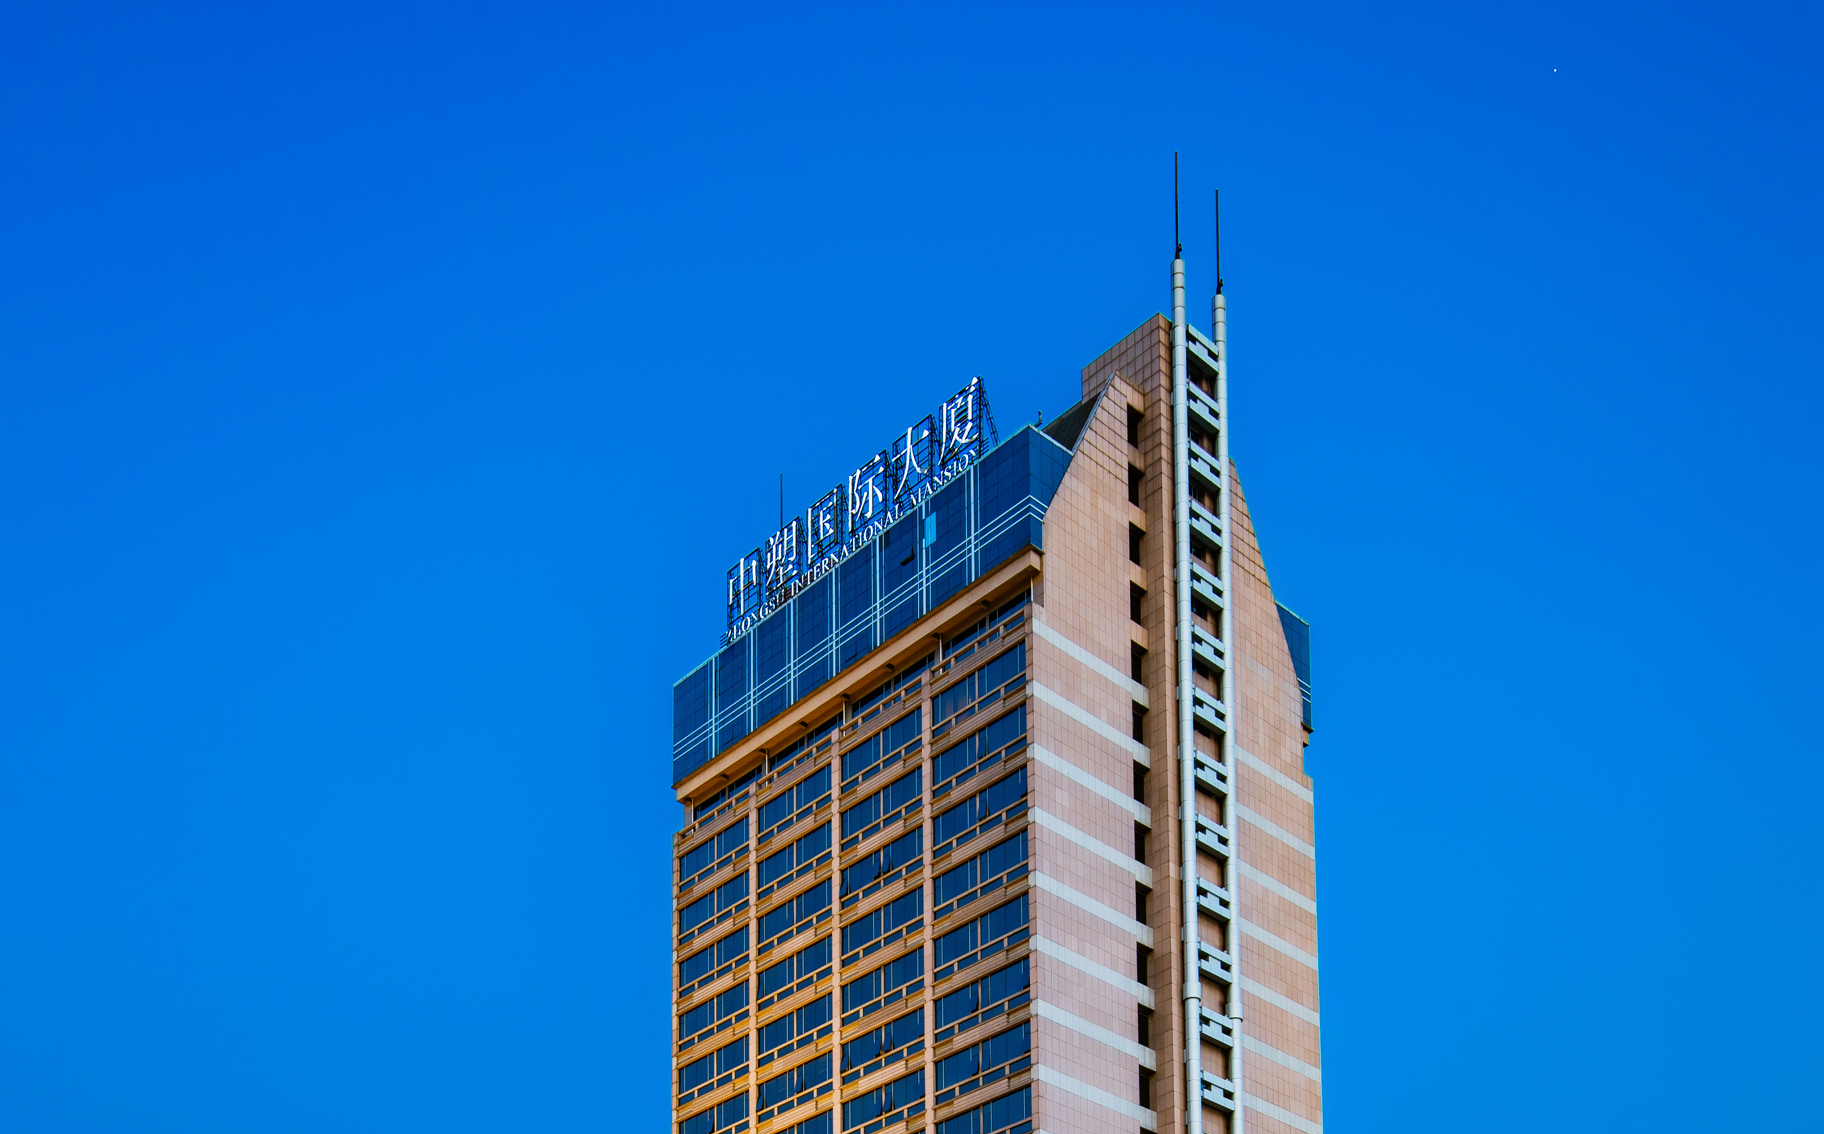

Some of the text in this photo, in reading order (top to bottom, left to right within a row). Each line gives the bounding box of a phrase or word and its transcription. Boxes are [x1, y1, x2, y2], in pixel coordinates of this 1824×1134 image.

[728, 376, 980, 616] 中塑国际大厦
[790, 503, 905, 598] INTERNATIONAL
[910, 448, 980, 508] MANSION
